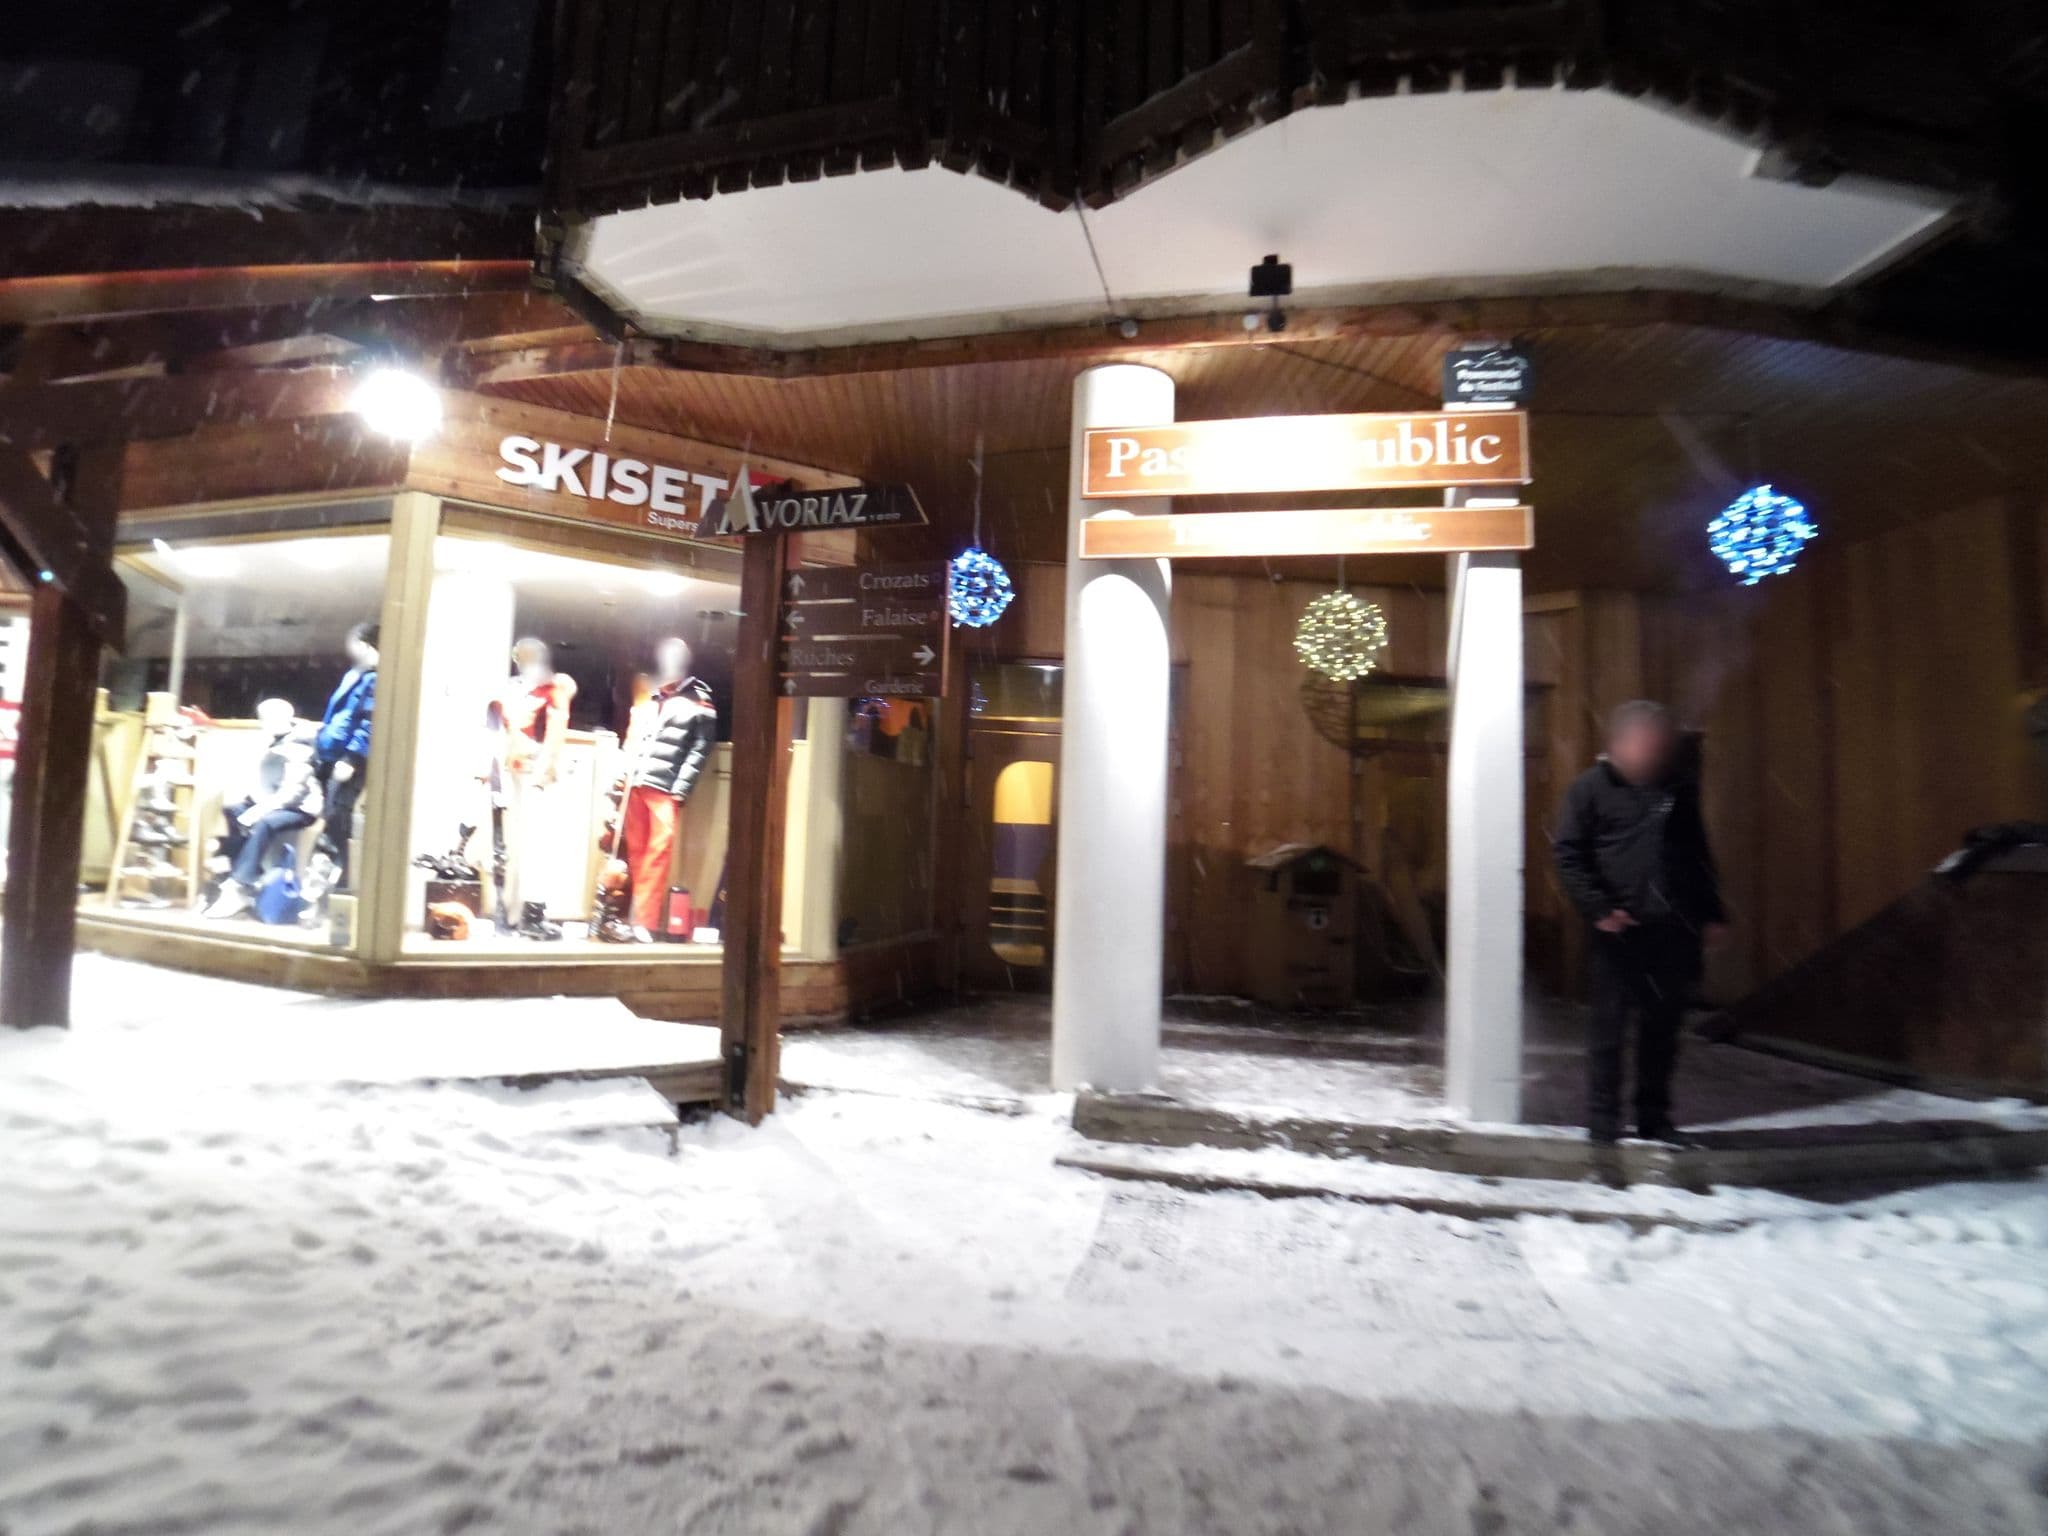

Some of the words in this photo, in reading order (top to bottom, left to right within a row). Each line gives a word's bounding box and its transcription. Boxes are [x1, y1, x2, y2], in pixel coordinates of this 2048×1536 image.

[1355, 419, 1503, 468] ublic
[495, 434, 729, 521] SKISET
[715, 464, 867, 535] AVORIAZ
[647, 511, 698, 532] Supers
[859, 572, 930, 590] Crozats
[861, 607, 928, 627] Falaise
